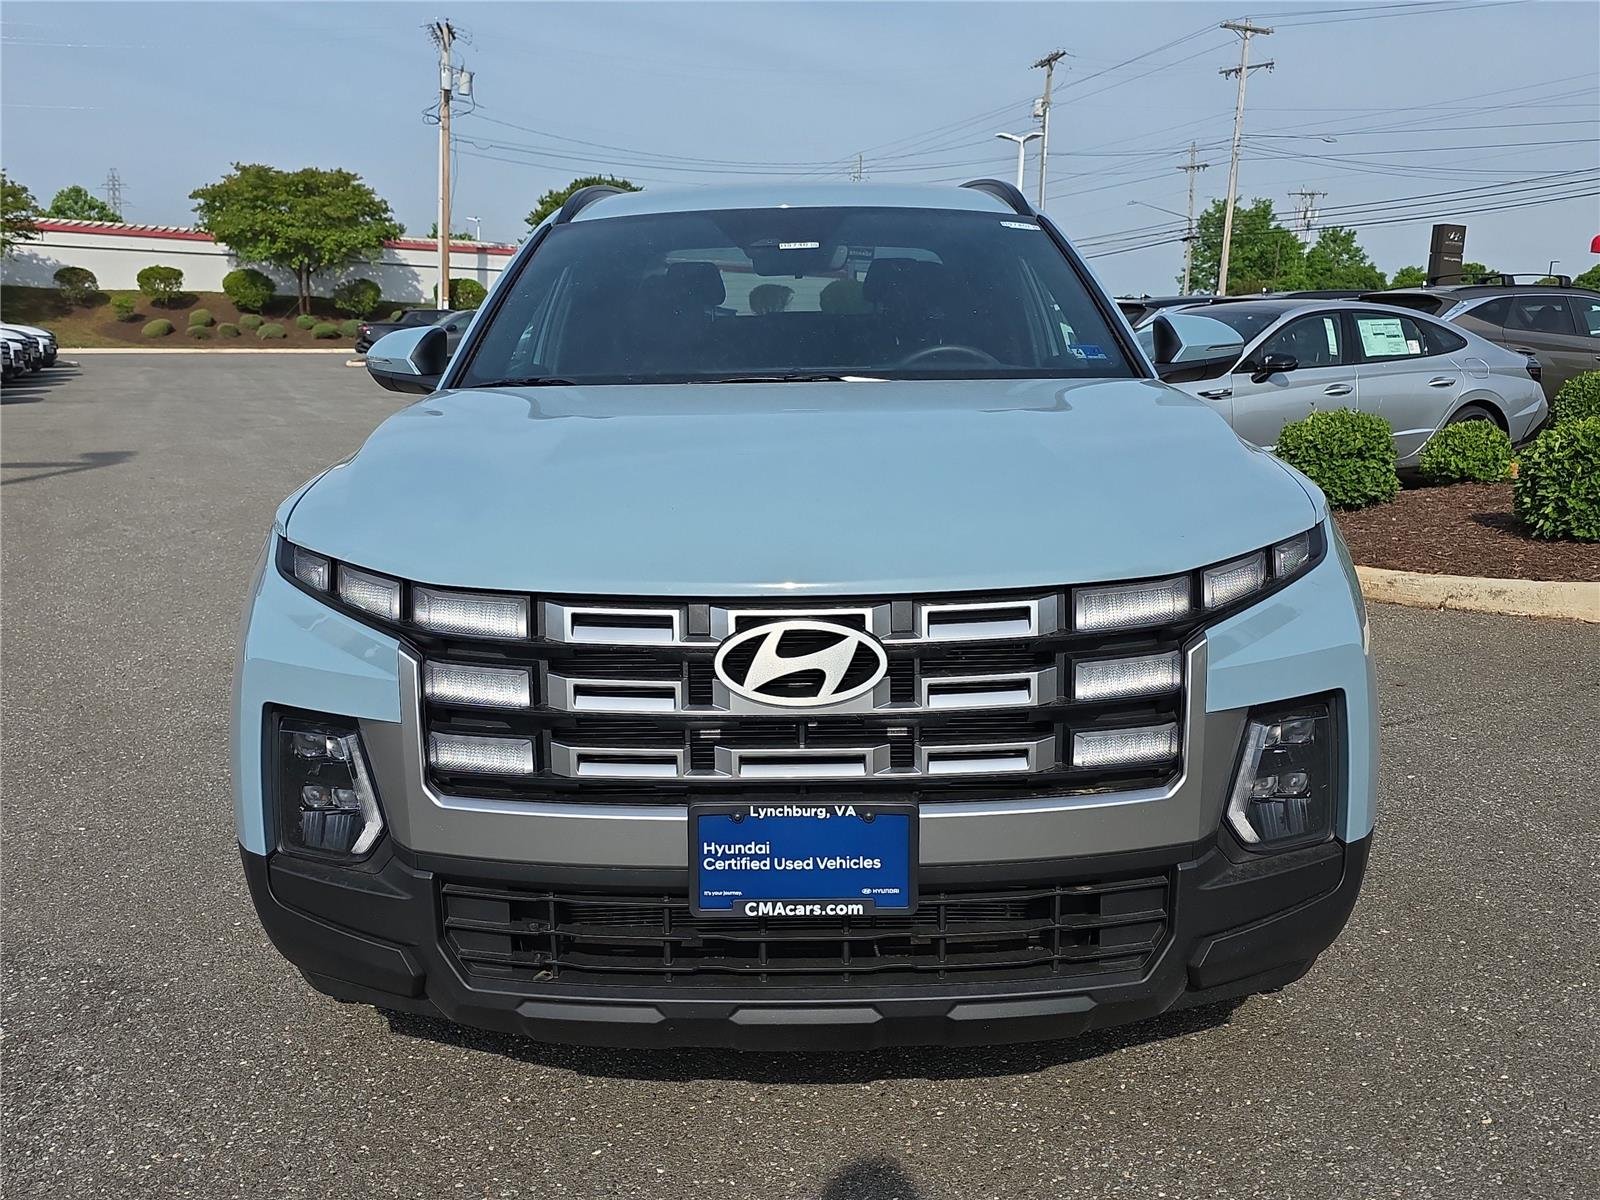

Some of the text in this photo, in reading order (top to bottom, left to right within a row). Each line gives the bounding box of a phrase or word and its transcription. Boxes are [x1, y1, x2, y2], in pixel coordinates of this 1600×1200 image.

[749, 804, 857, 819] Lynchburg, VA
[703, 841, 770, 857] Hyundai
[703, 856, 882, 870] Certified Used Vehicles
[744, 901, 864, 917] CMAcars.com
